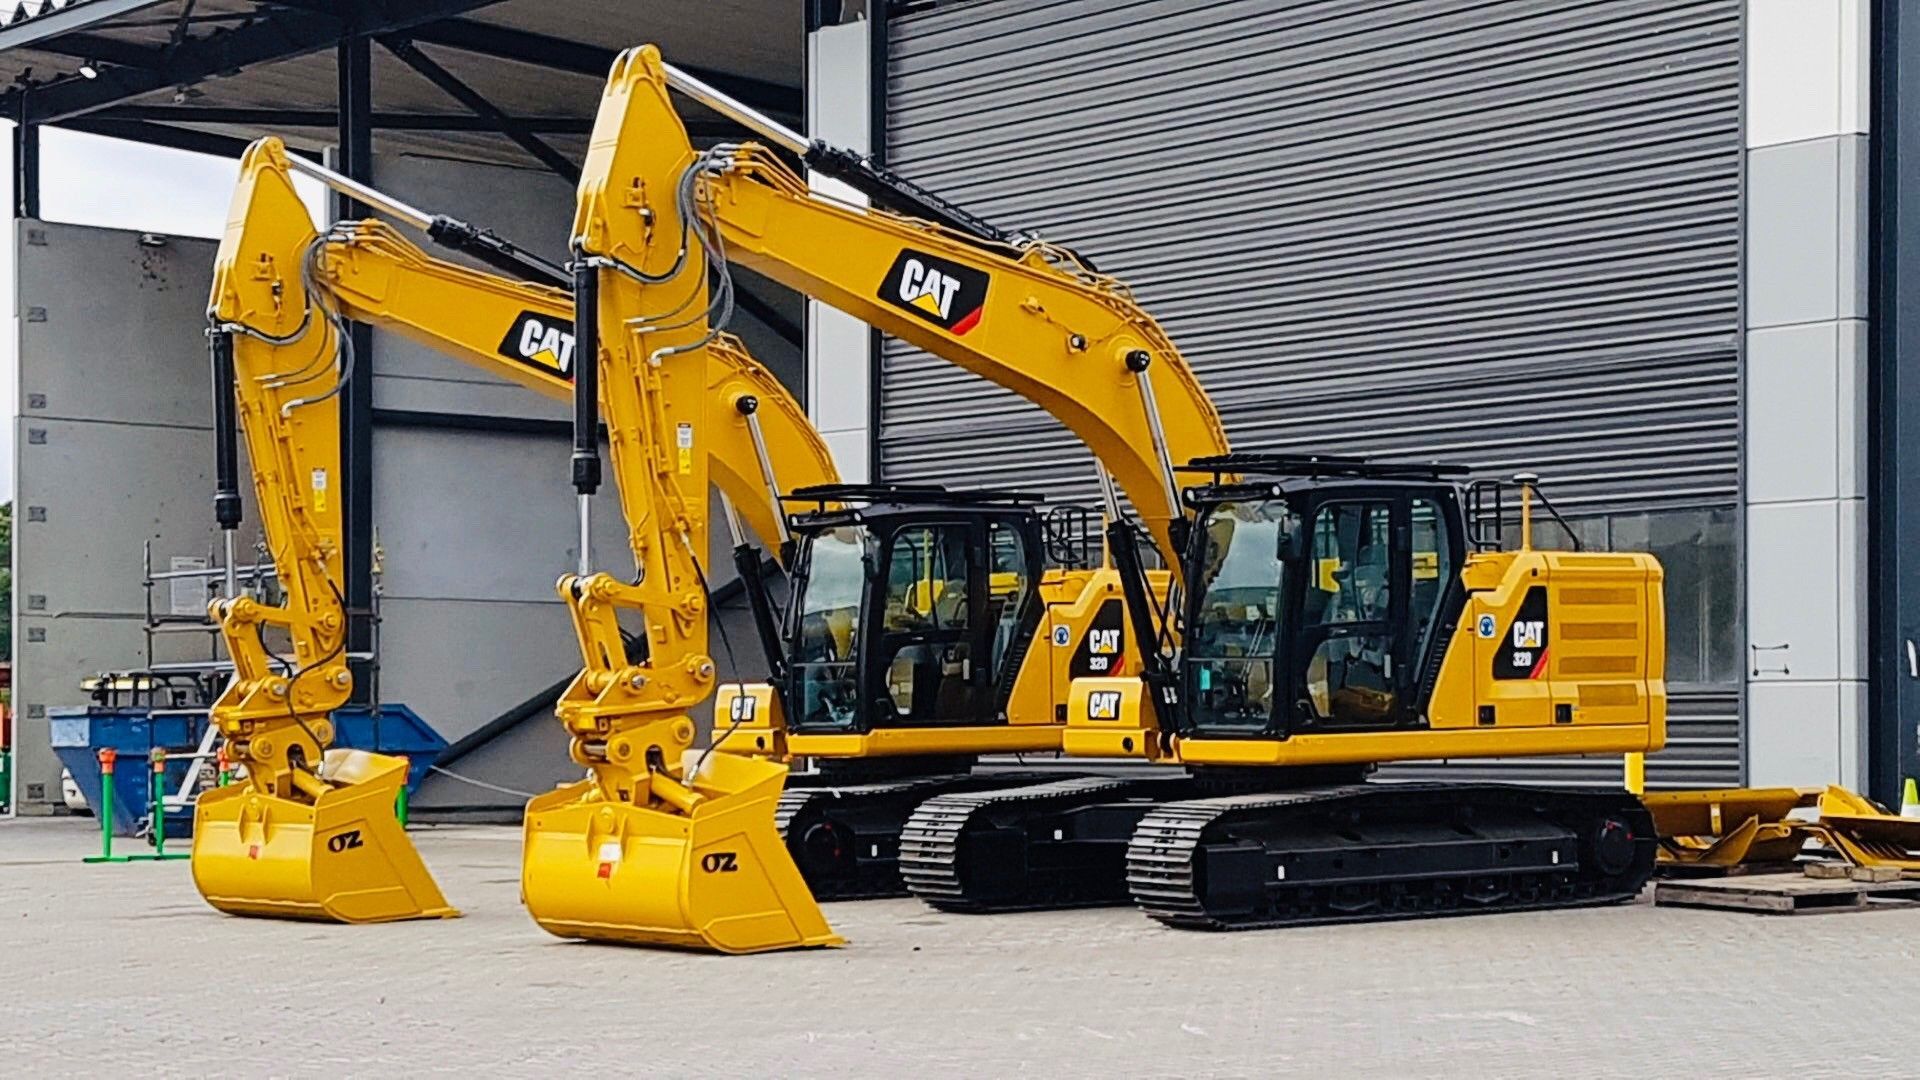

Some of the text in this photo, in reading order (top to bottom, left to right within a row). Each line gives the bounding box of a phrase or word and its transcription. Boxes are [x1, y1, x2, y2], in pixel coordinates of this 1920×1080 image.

[899, 258, 961, 321] CAT
[518, 318, 576, 373] CAT
[1089, 629, 1120, 653] CAT
[1513, 621, 1545, 648] CAT
[1089, 657, 1108, 670] 320
[1512, 651, 1532, 667] 320
[1089, 692, 1119, 718] CAT
